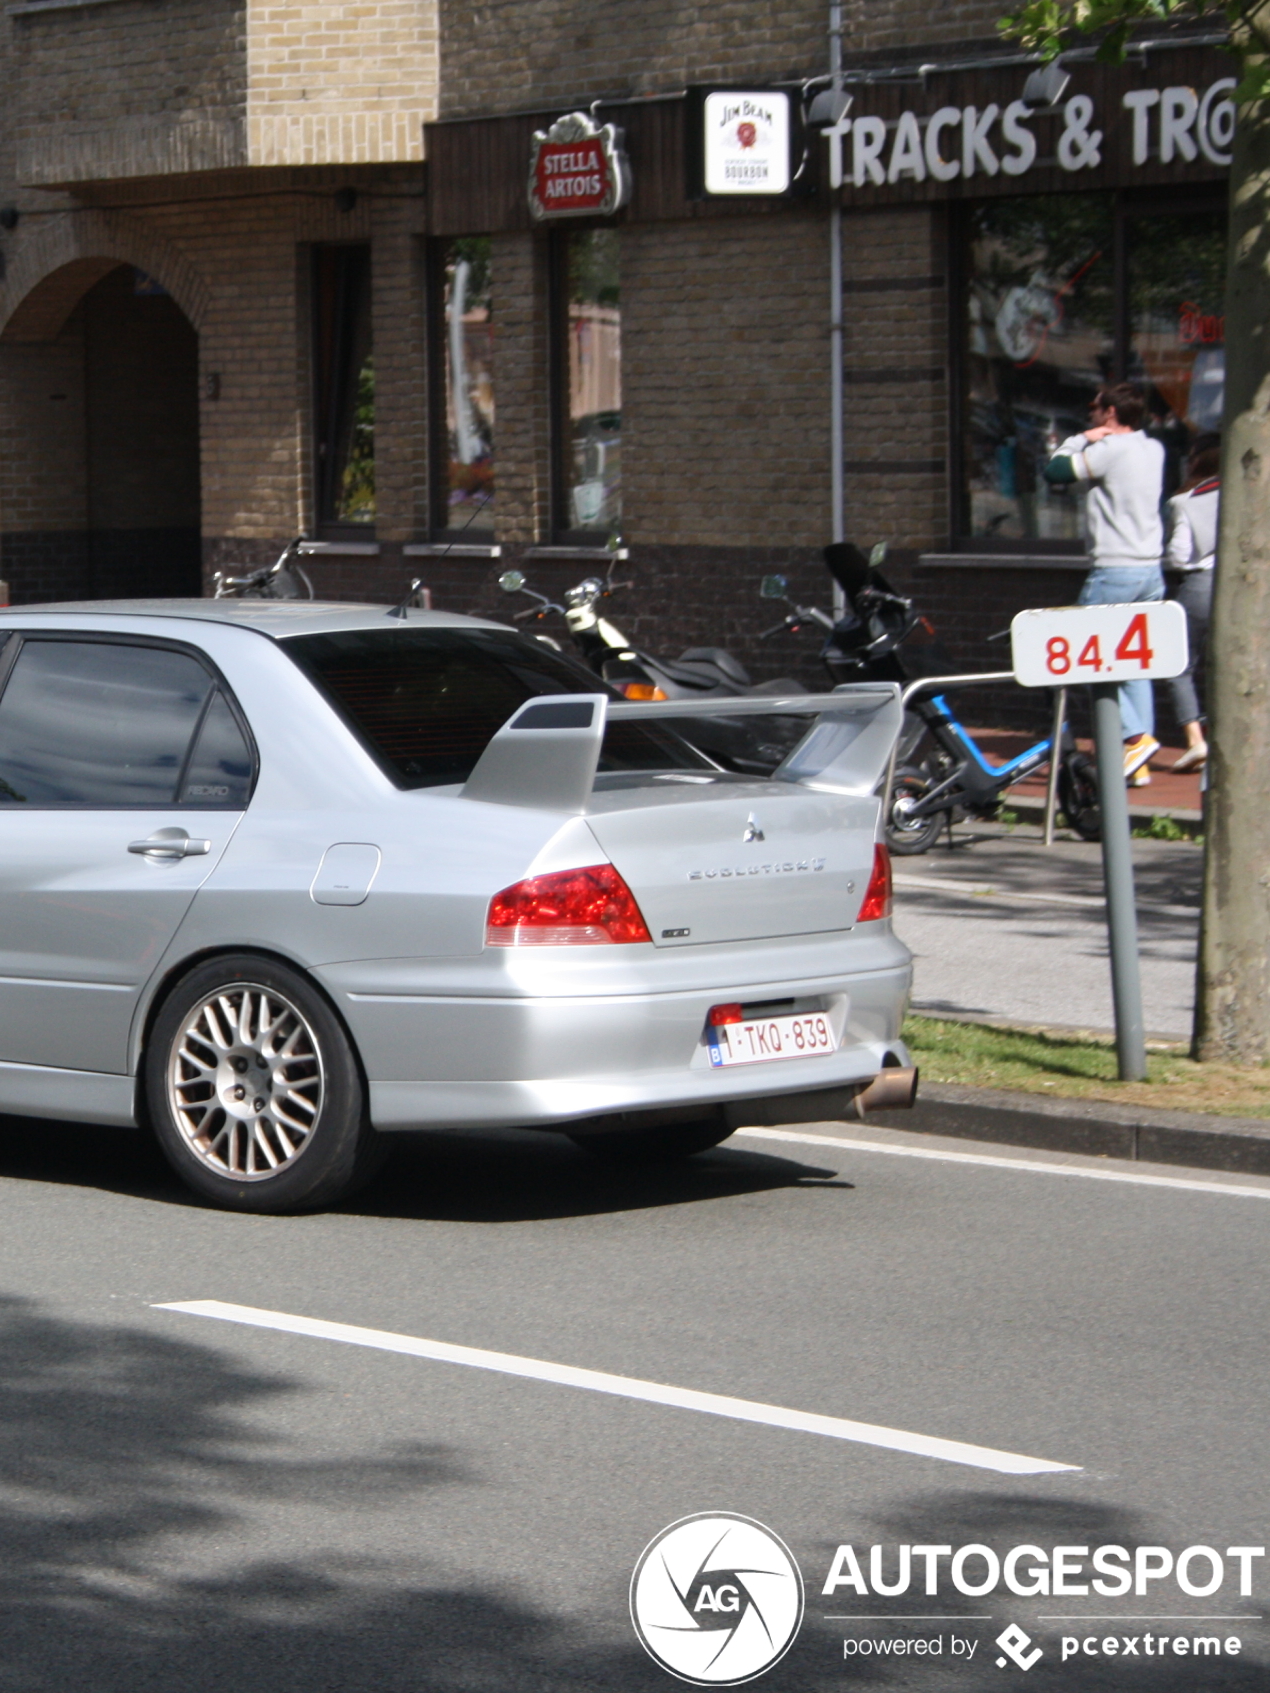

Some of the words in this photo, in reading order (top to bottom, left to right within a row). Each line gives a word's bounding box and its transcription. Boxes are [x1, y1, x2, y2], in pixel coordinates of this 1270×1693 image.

[720, 105, 740, 127] JIM
[820, 100, 1036, 189] TRACKS
[1058, 94, 1103, 172] &
[544, 151, 600, 175] STELLA
[725, 166, 768, 179] BOURBON
[545, 174, 601, 199] ARTOIS
[1045, 613, 1154, 676] 84.4
[687, 860, 809, 881] EVOLUTION
[711, 1047, 720, 1063] B
